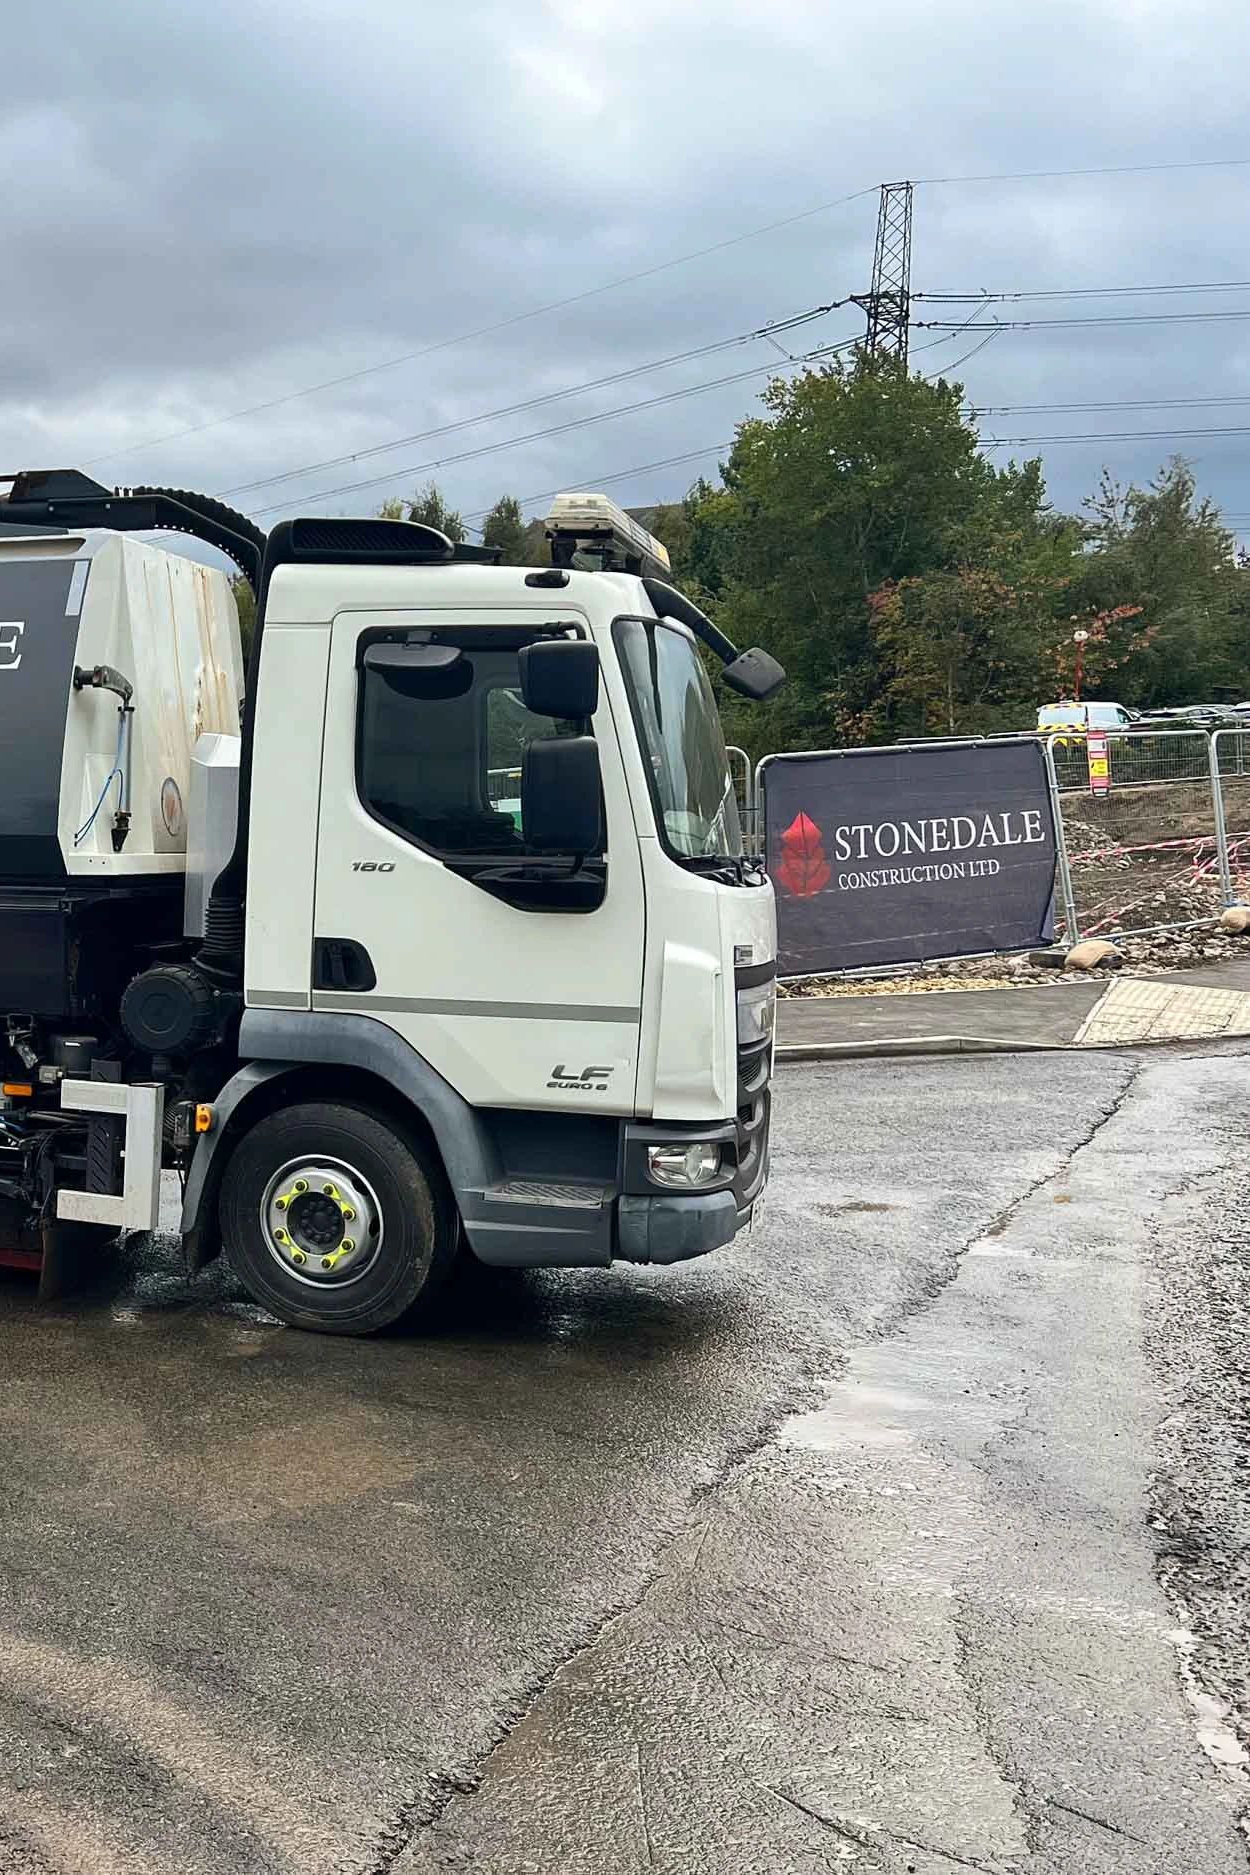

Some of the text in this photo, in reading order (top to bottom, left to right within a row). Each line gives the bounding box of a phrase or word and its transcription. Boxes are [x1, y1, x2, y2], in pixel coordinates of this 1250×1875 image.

[835, 810, 1046, 861] STONEDALE
[352, 862, 396, 872] 180
[838, 858, 1000, 890] CONSTRUCTION LTD
[551, 1064, 614, 1081] LF
[546, 1081, 593, 1090] EURO
